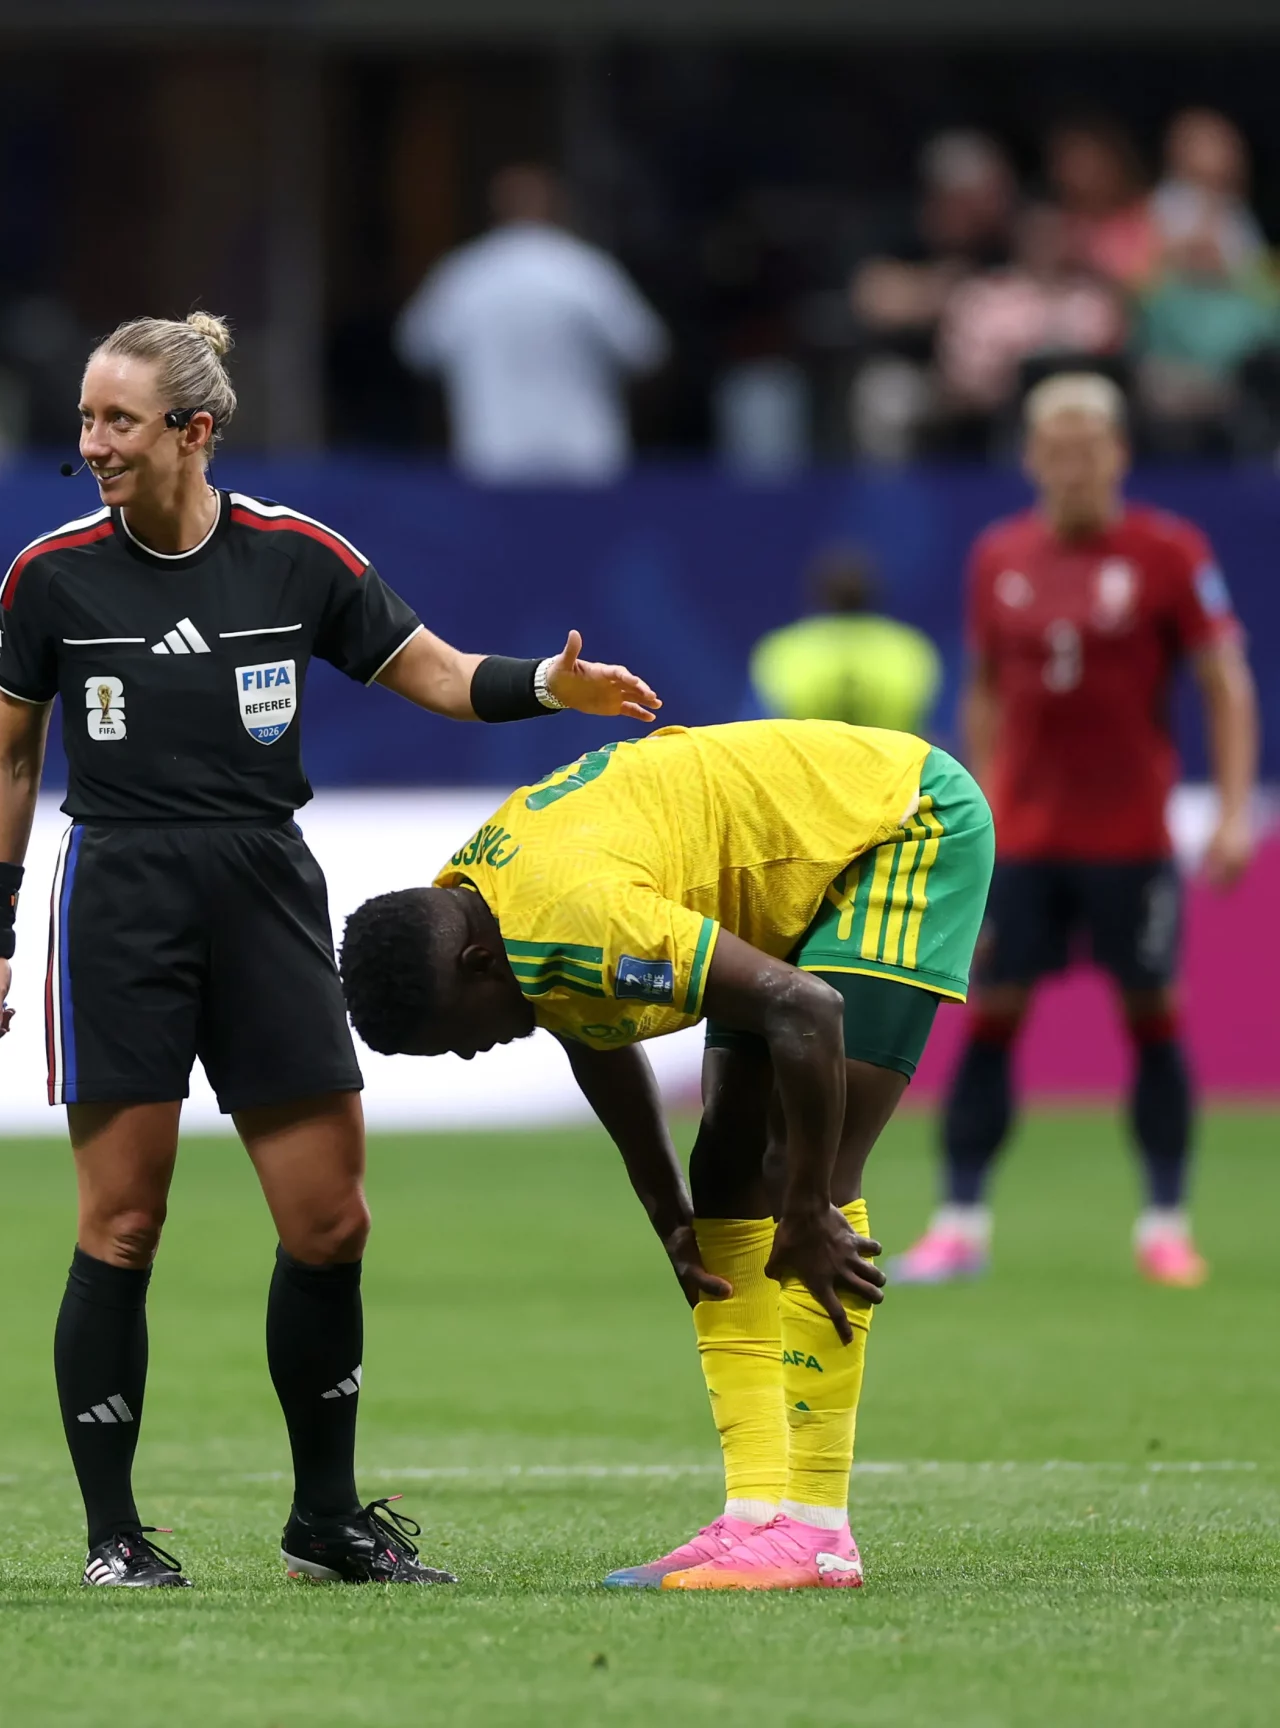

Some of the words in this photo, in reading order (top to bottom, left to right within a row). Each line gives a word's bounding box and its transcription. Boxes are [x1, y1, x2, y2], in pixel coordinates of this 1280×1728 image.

[242, 666, 291, 691] FIFA
[245, 698, 292, 715] REFEREE
[99, 727, 116, 735] FIFA
[258, 726, 280, 738] 2026
[782, 1349, 824, 1373] AFA
